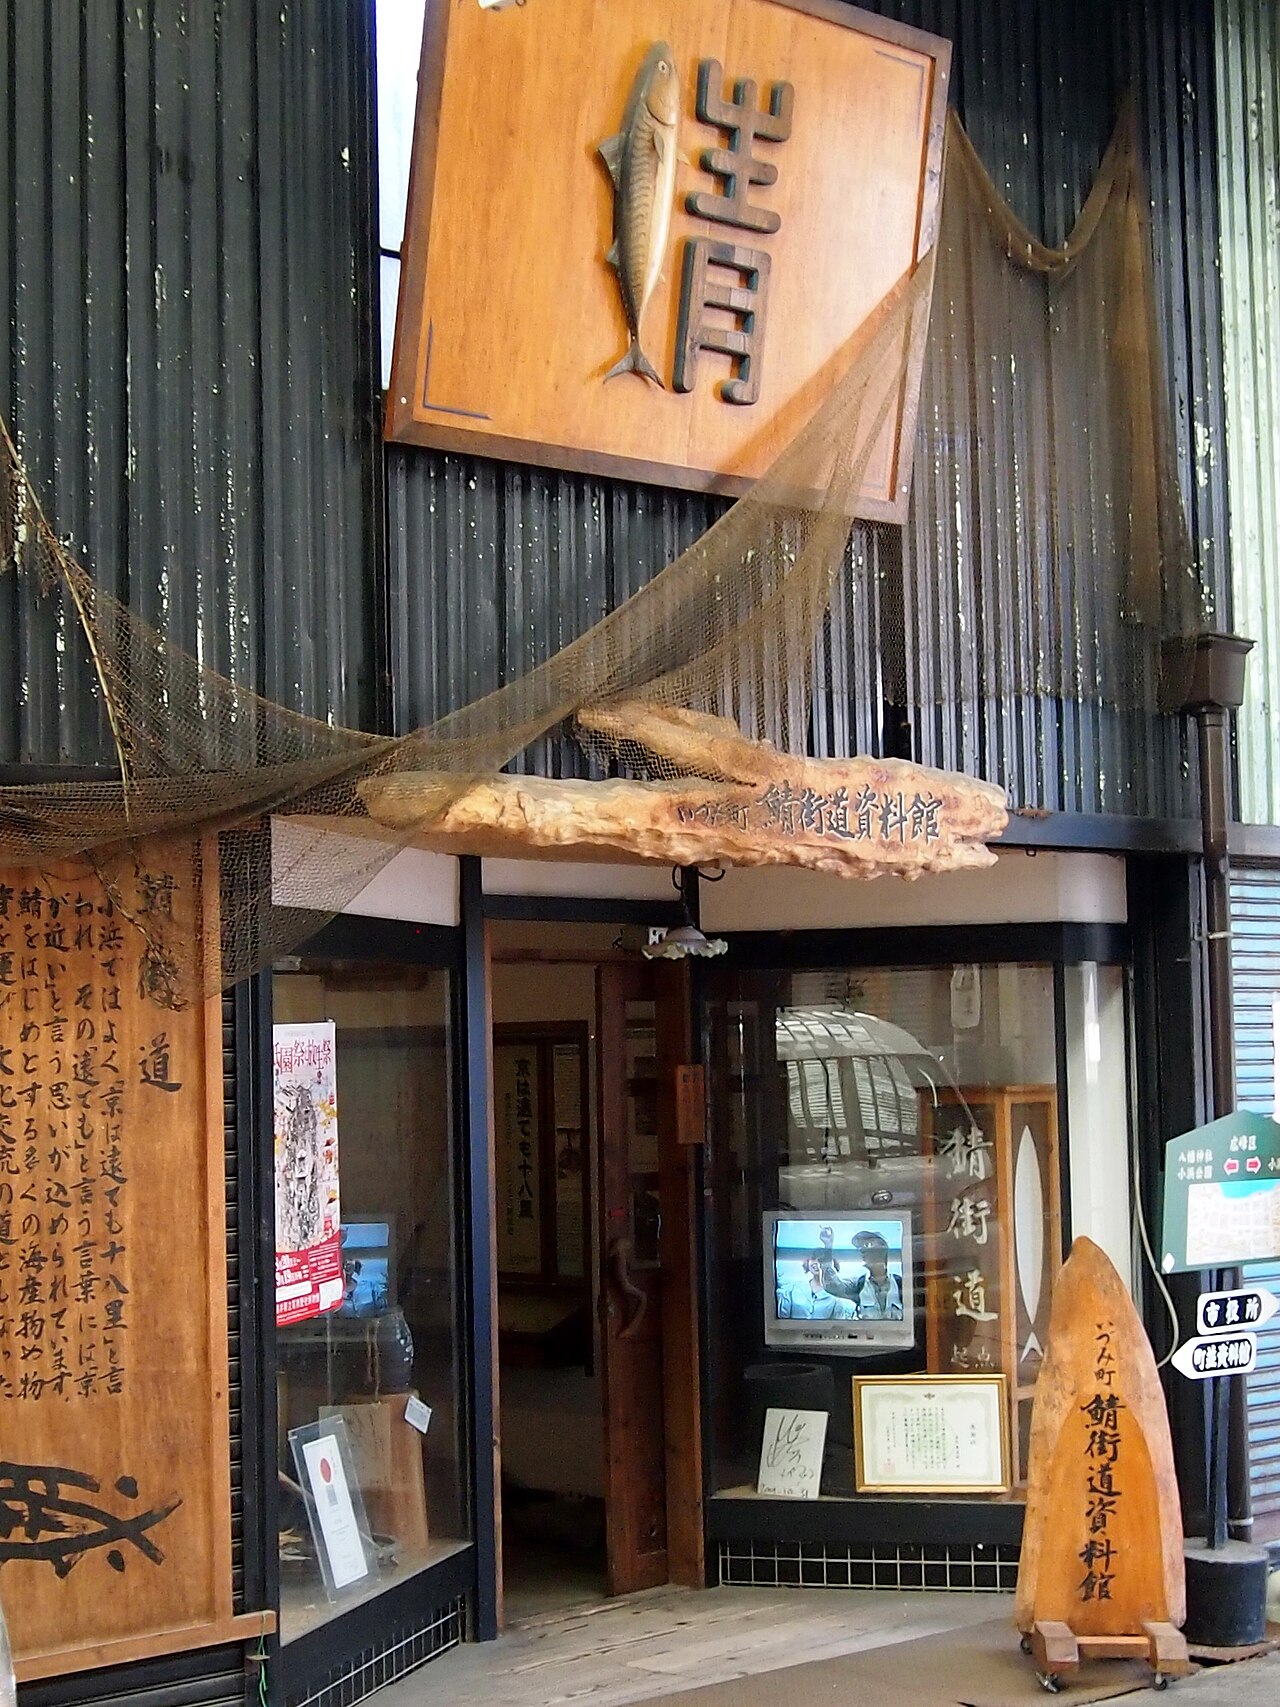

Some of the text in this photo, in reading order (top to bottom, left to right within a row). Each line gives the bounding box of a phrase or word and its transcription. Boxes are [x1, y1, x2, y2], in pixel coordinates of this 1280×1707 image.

[757, 781, 944, 844] 鯖街道資料館
[939, 1126, 998, 1323] 鯖街道
[1205, 1296, 1260, 1327] 市役所
[1078, 1394, 1126, 1602] 鯖街道資料館
